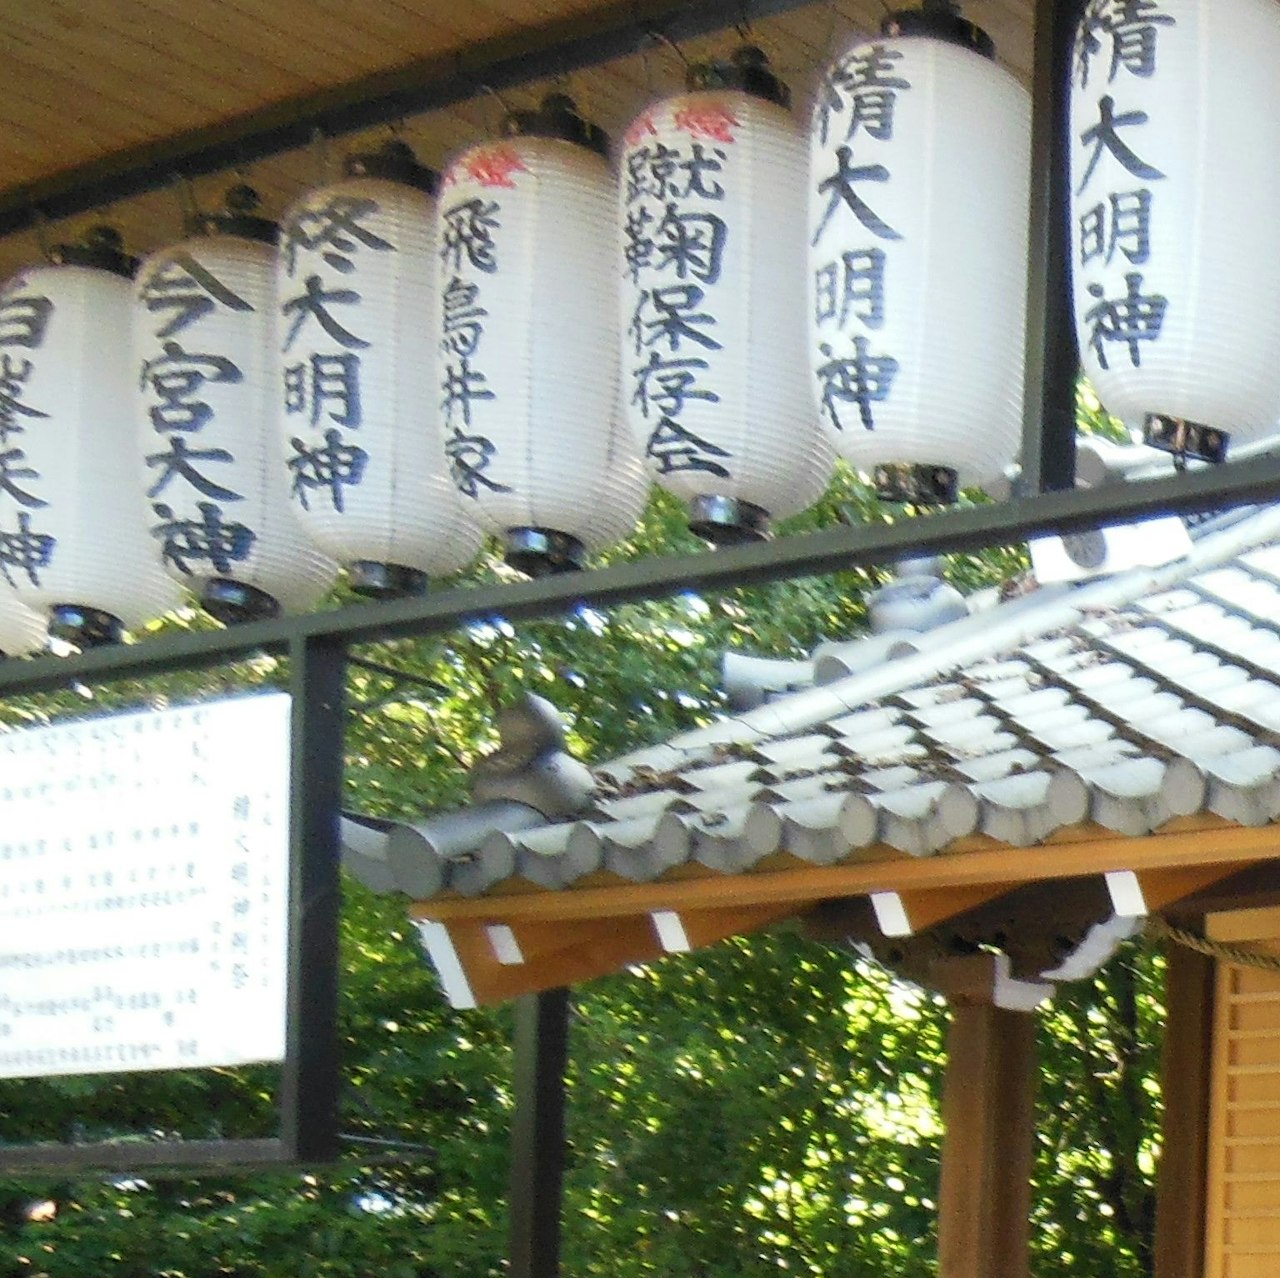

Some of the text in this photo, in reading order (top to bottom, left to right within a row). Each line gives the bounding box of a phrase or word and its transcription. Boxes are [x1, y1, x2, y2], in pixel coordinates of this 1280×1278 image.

[283, 197, 398, 514] 柊大明神
[440, 198, 513, 499] 飛鳥井家
[622, 141, 734, 479] 蹴鞠保存会
[812, 44, 911, 431] 精大明神
[139, 250, 257, 577] 今宮大神
